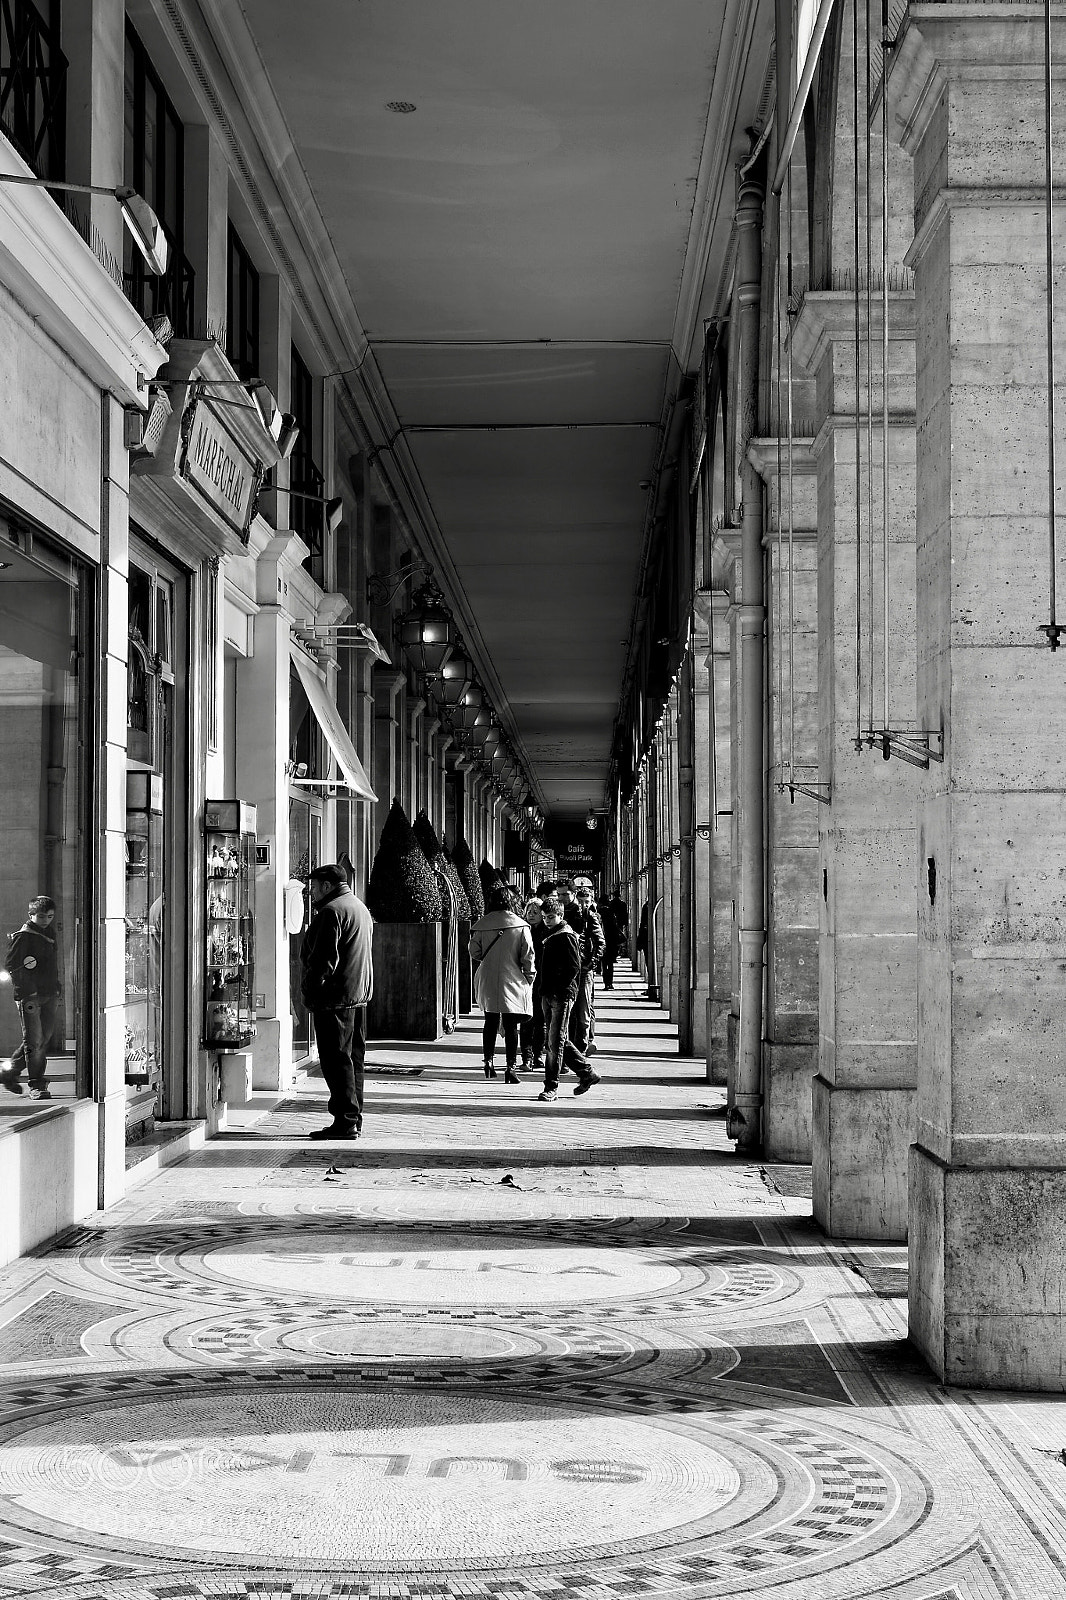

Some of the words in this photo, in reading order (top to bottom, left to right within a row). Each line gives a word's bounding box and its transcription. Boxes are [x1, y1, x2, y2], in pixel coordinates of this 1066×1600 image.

[194, 421, 245, 512] MARECHAL
[567, 844, 585, 853] Café
[260, 1253, 622, 1277] SULKA
[91, 1443, 650, 1484] SULKA
